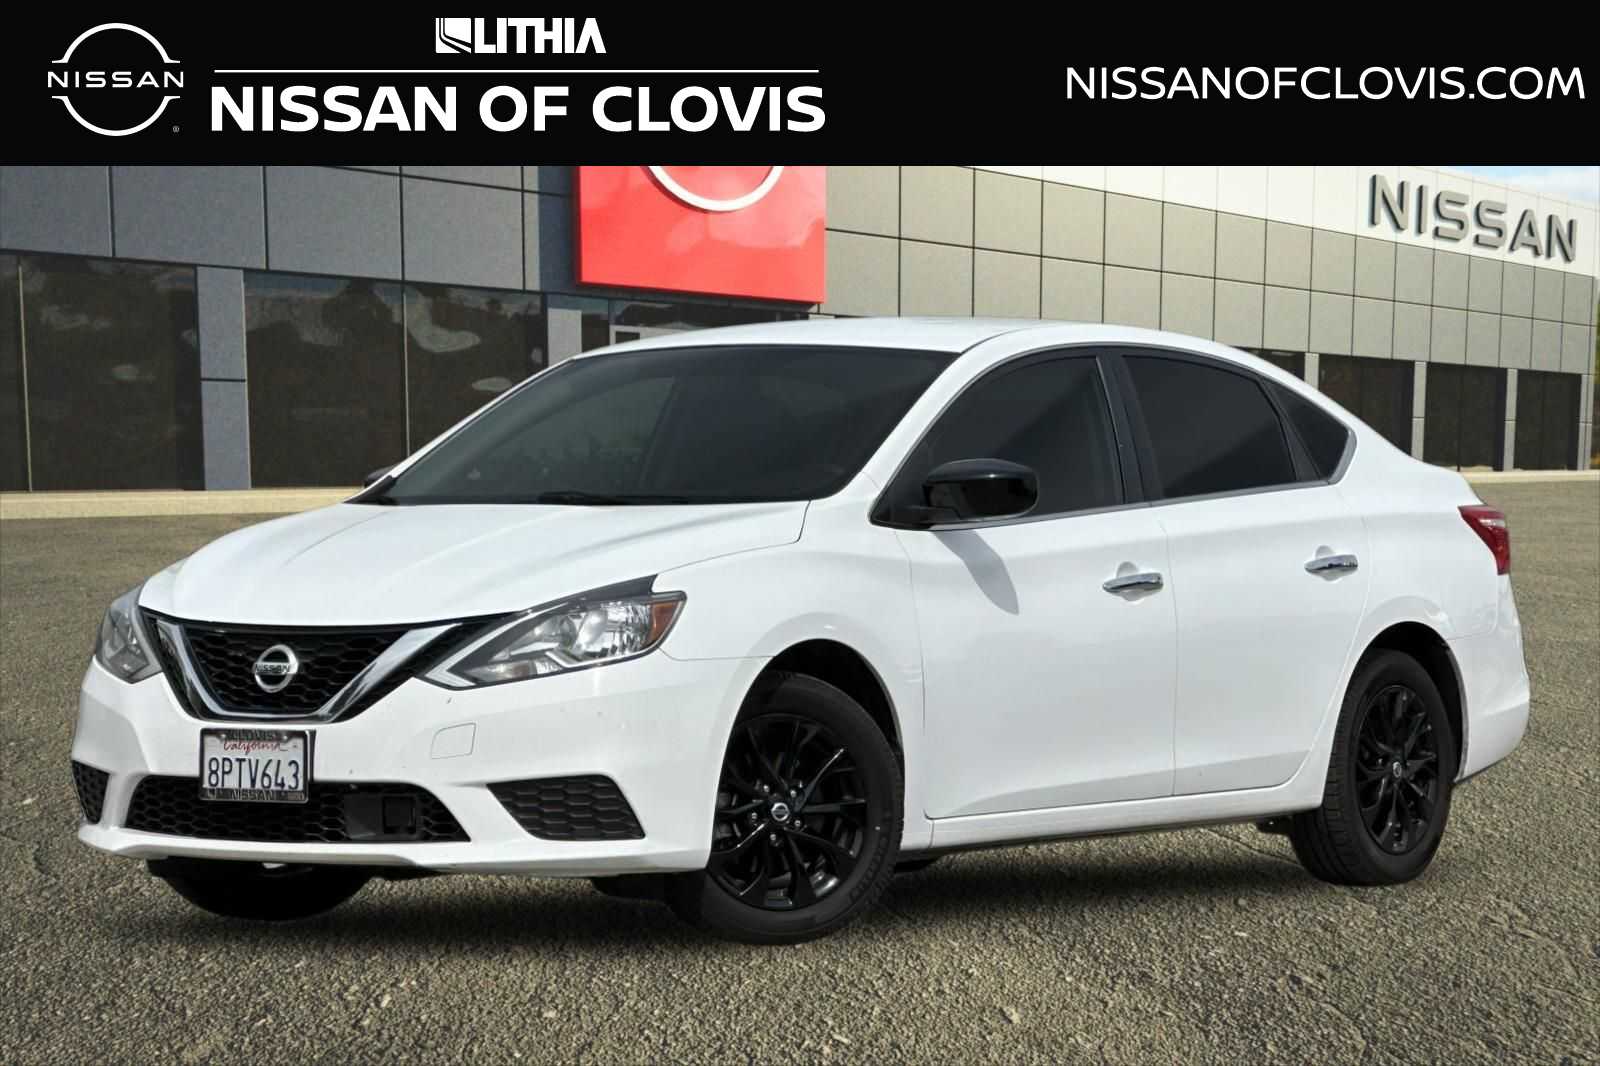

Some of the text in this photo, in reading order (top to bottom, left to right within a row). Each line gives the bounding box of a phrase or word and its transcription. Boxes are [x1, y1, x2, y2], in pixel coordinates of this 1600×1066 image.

[1368, 174, 1577, 263] NISSAN
[255, 662, 290, 674] NISSAN
[208, 756, 300, 791] 8PTV643
[231, 788, 274, 801] NISSAN
